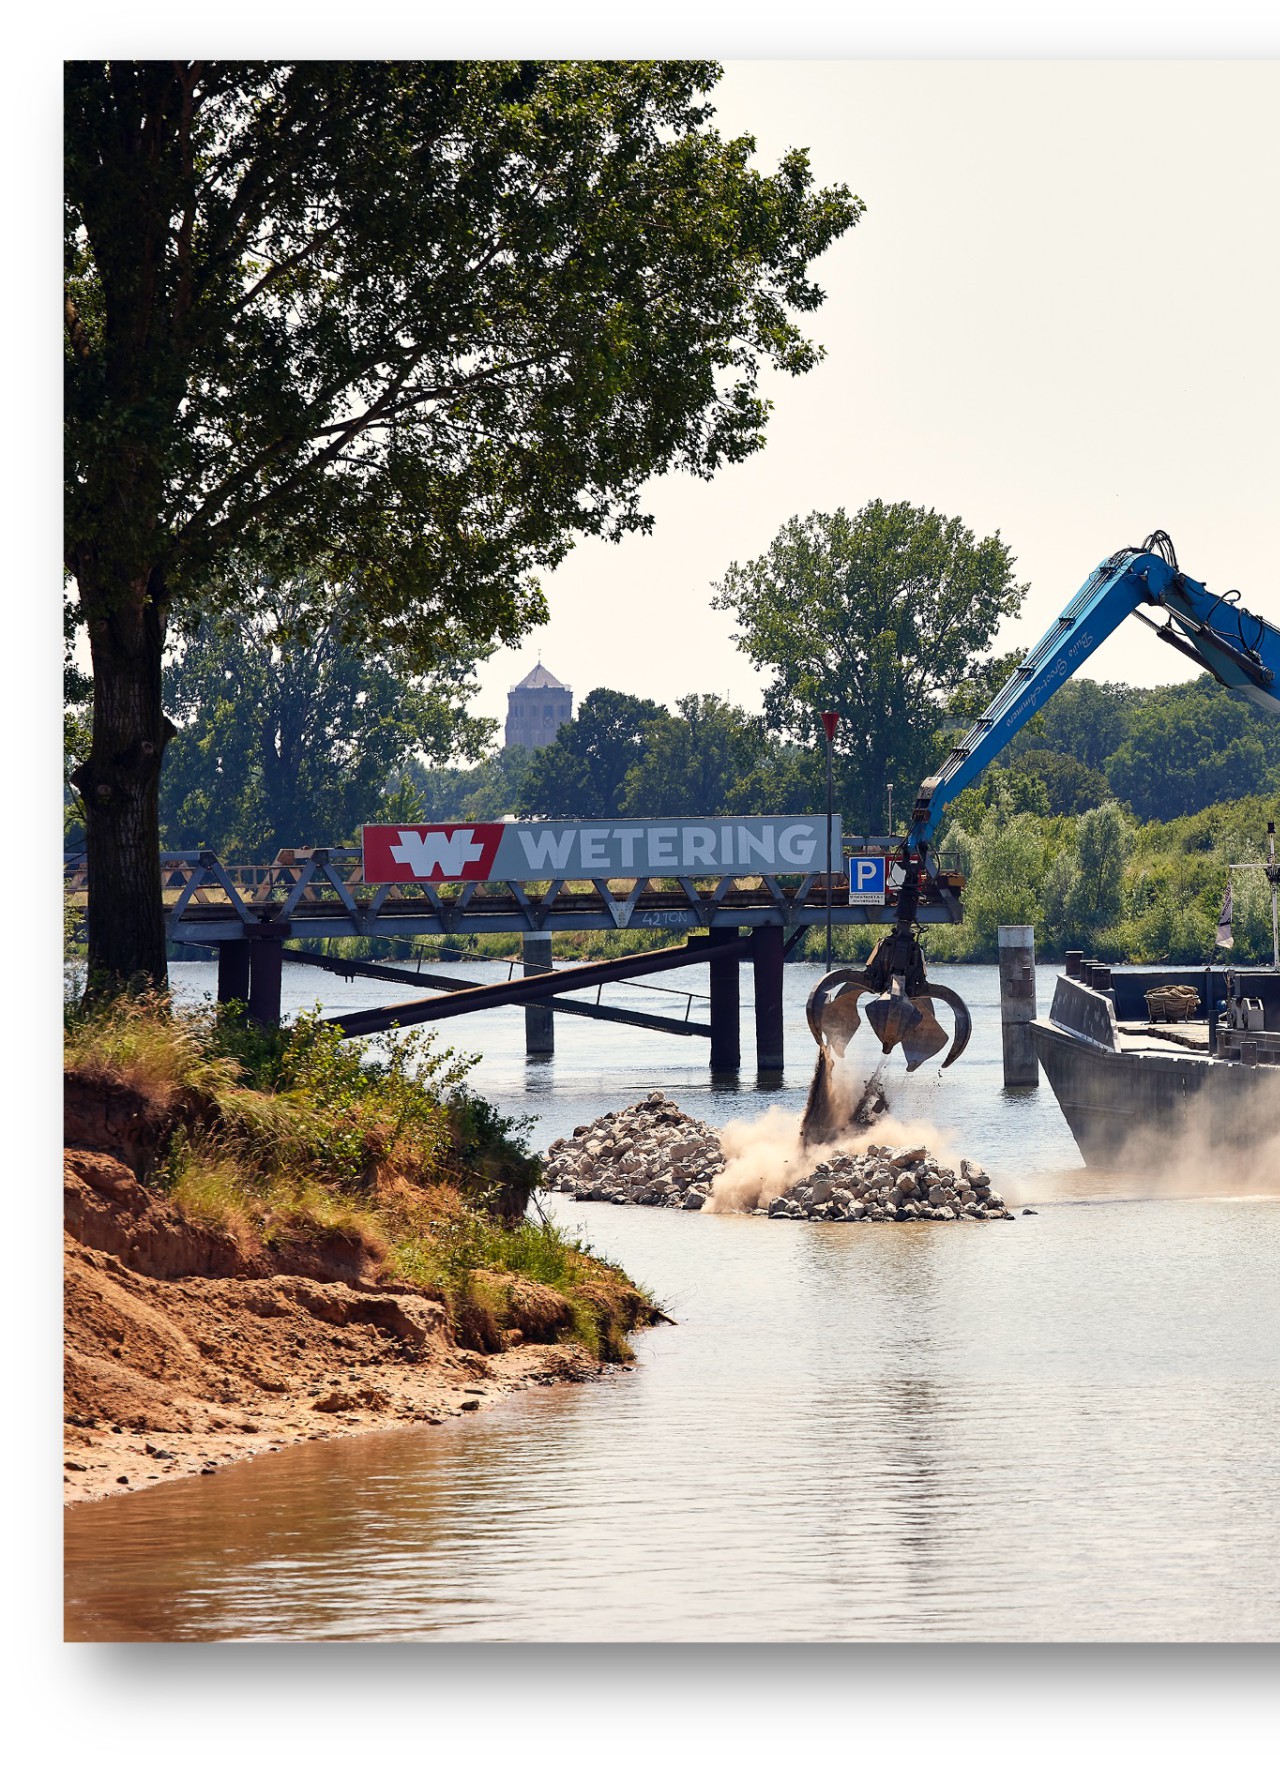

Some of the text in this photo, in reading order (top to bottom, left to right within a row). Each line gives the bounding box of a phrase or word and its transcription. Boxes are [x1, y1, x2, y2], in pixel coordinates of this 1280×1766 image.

[518, 824, 817, 870] WETERING
[857, 861, 877, 890] P
[642, 911, 688, 926] 42 TON
